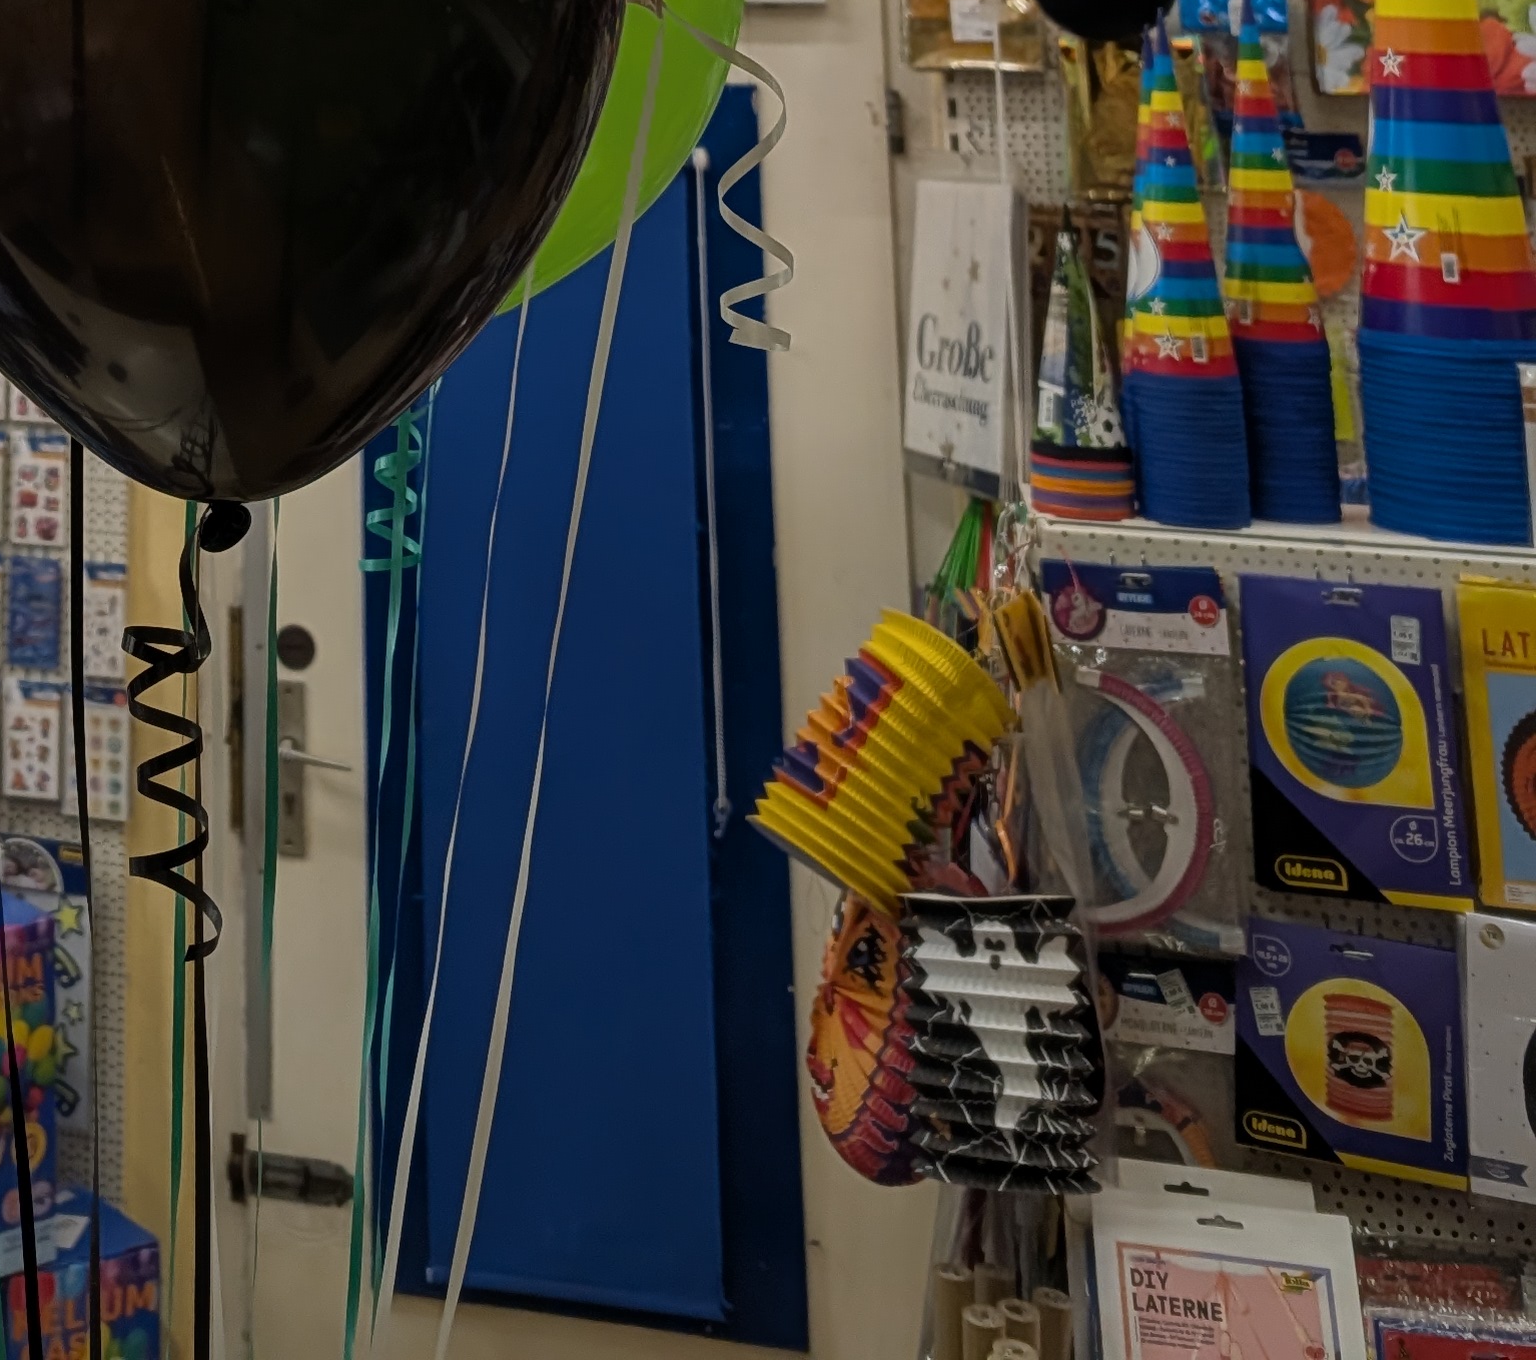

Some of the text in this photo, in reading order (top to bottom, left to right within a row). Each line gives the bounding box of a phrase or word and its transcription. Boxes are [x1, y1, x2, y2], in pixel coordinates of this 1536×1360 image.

[1436, 739, 1456, 828] Meerjungfrau
[1405, 832, 1424, 847] 26
[1446, 829, 1463, 886] Lampion
[1129, 1267, 1169, 1291] DIY
[1131, 1292, 1224, 1322] LATERNE
